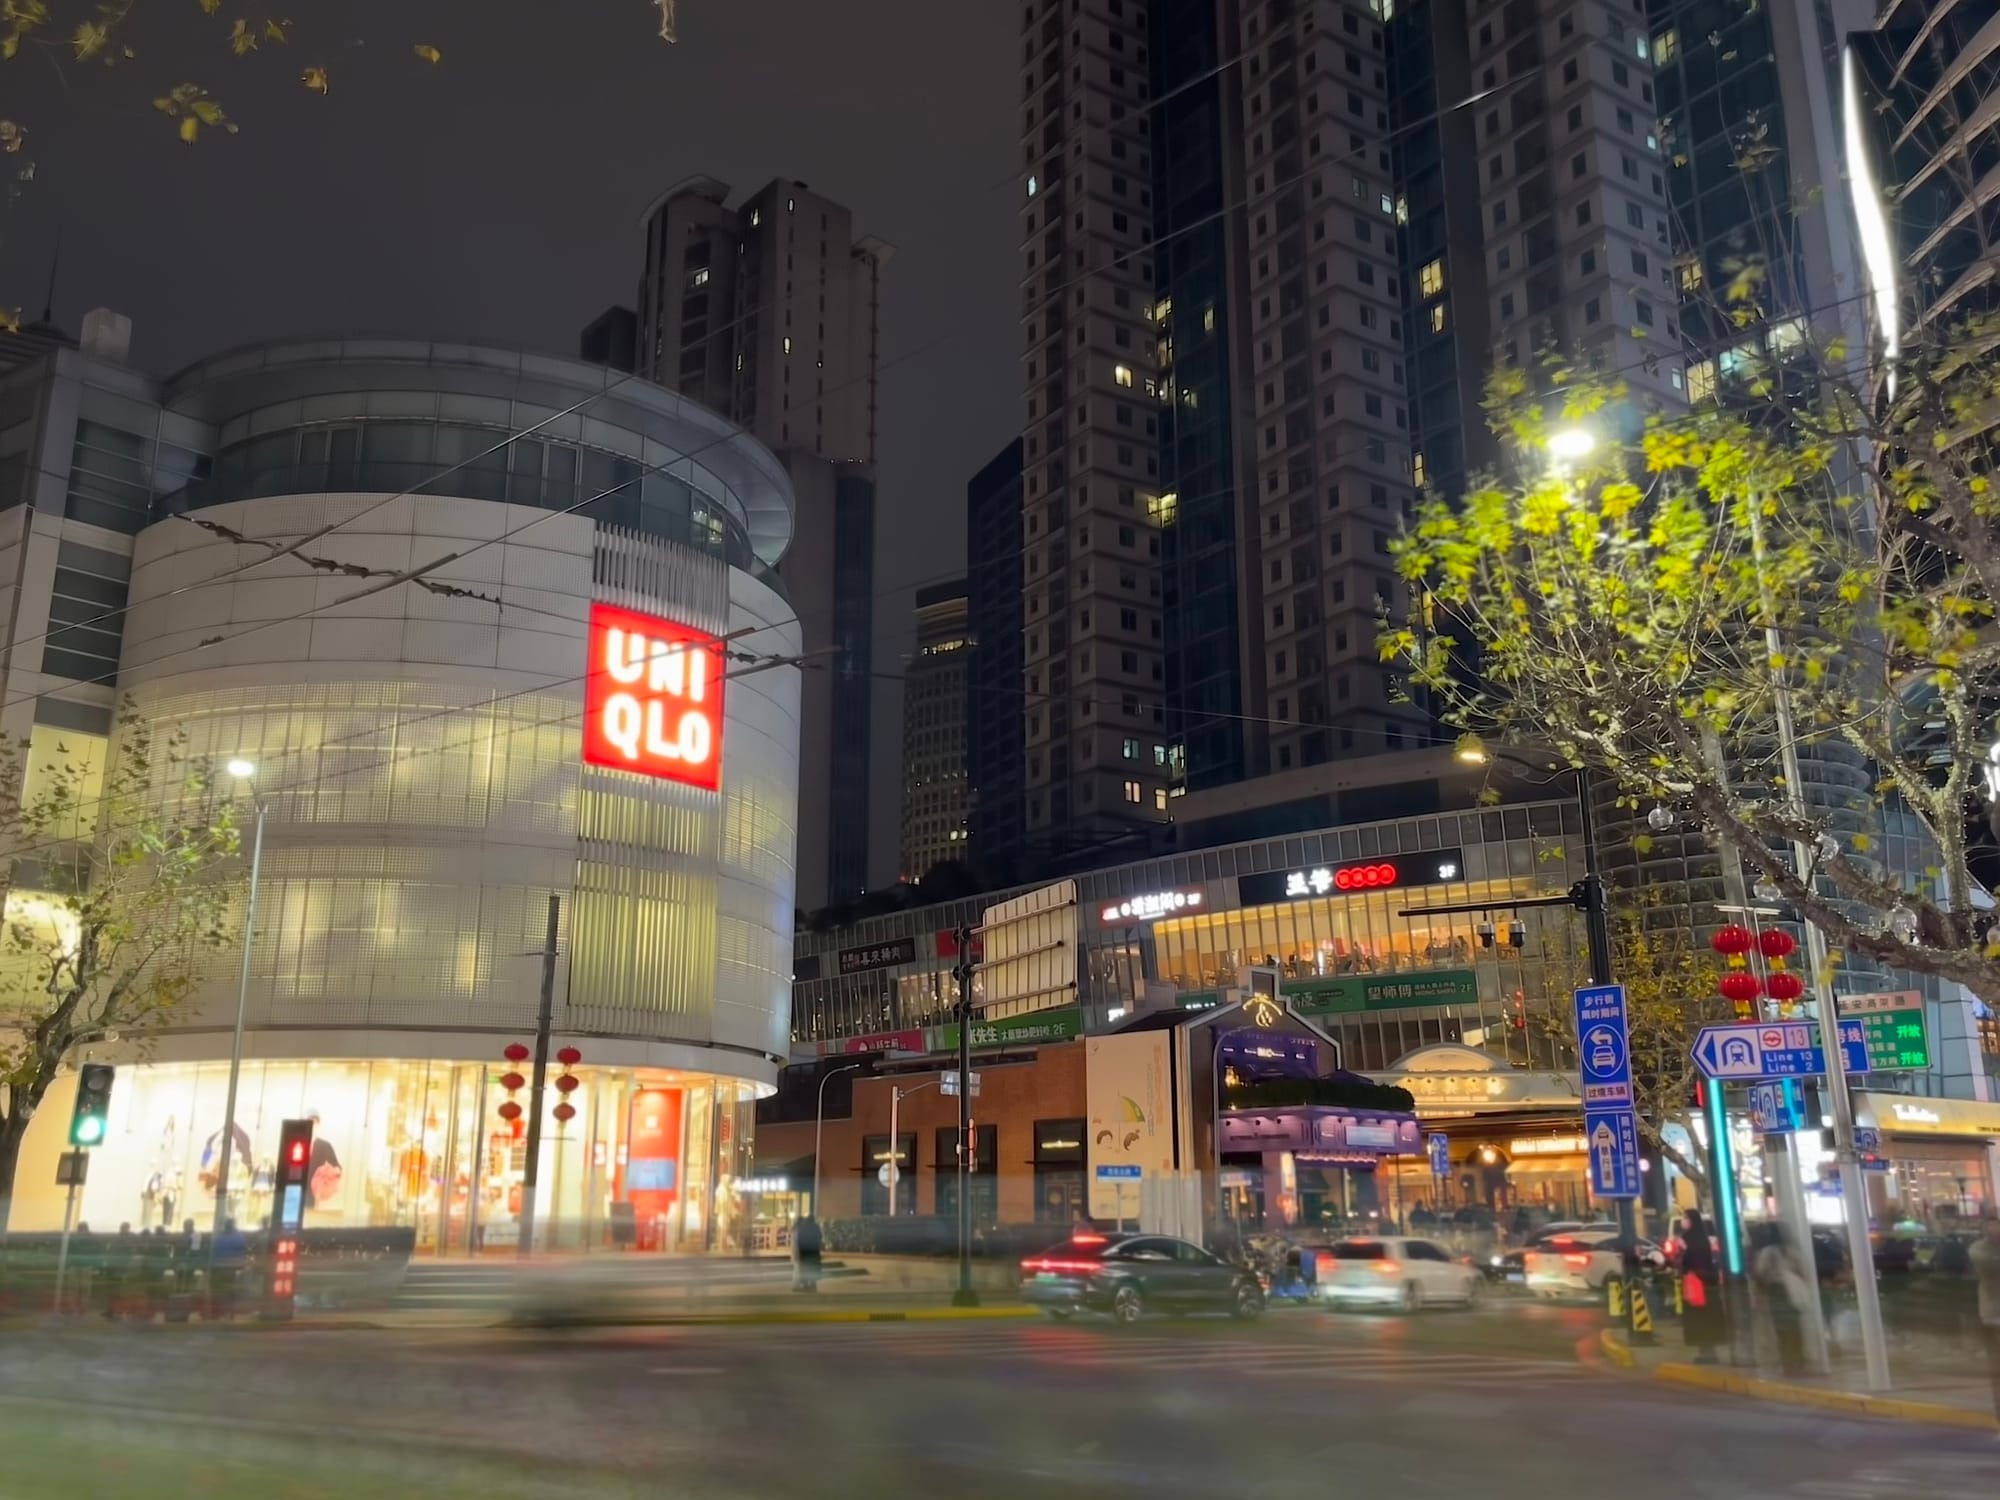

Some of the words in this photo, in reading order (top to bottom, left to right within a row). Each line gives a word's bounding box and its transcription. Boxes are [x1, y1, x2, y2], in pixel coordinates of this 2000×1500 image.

[606, 627, 706, 702] UNI
[603, 693, 711, 764] QLO
[1460, 984, 1473, 993] 2F
[1053, 1023, 1066, 1035] 2F
[1896, 1025, 1921, 1039] 开放
[1790, 1028, 1806, 1047] 13
[1765, 1052, 1794, 1062] Line
[1799, 1051, 1813, 1060] 13
[1900, 1051, 1925, 1065] 开放
[1767, 1063, 1795, 1073] Line
[1805, 1062, 1814, 1071] 2
